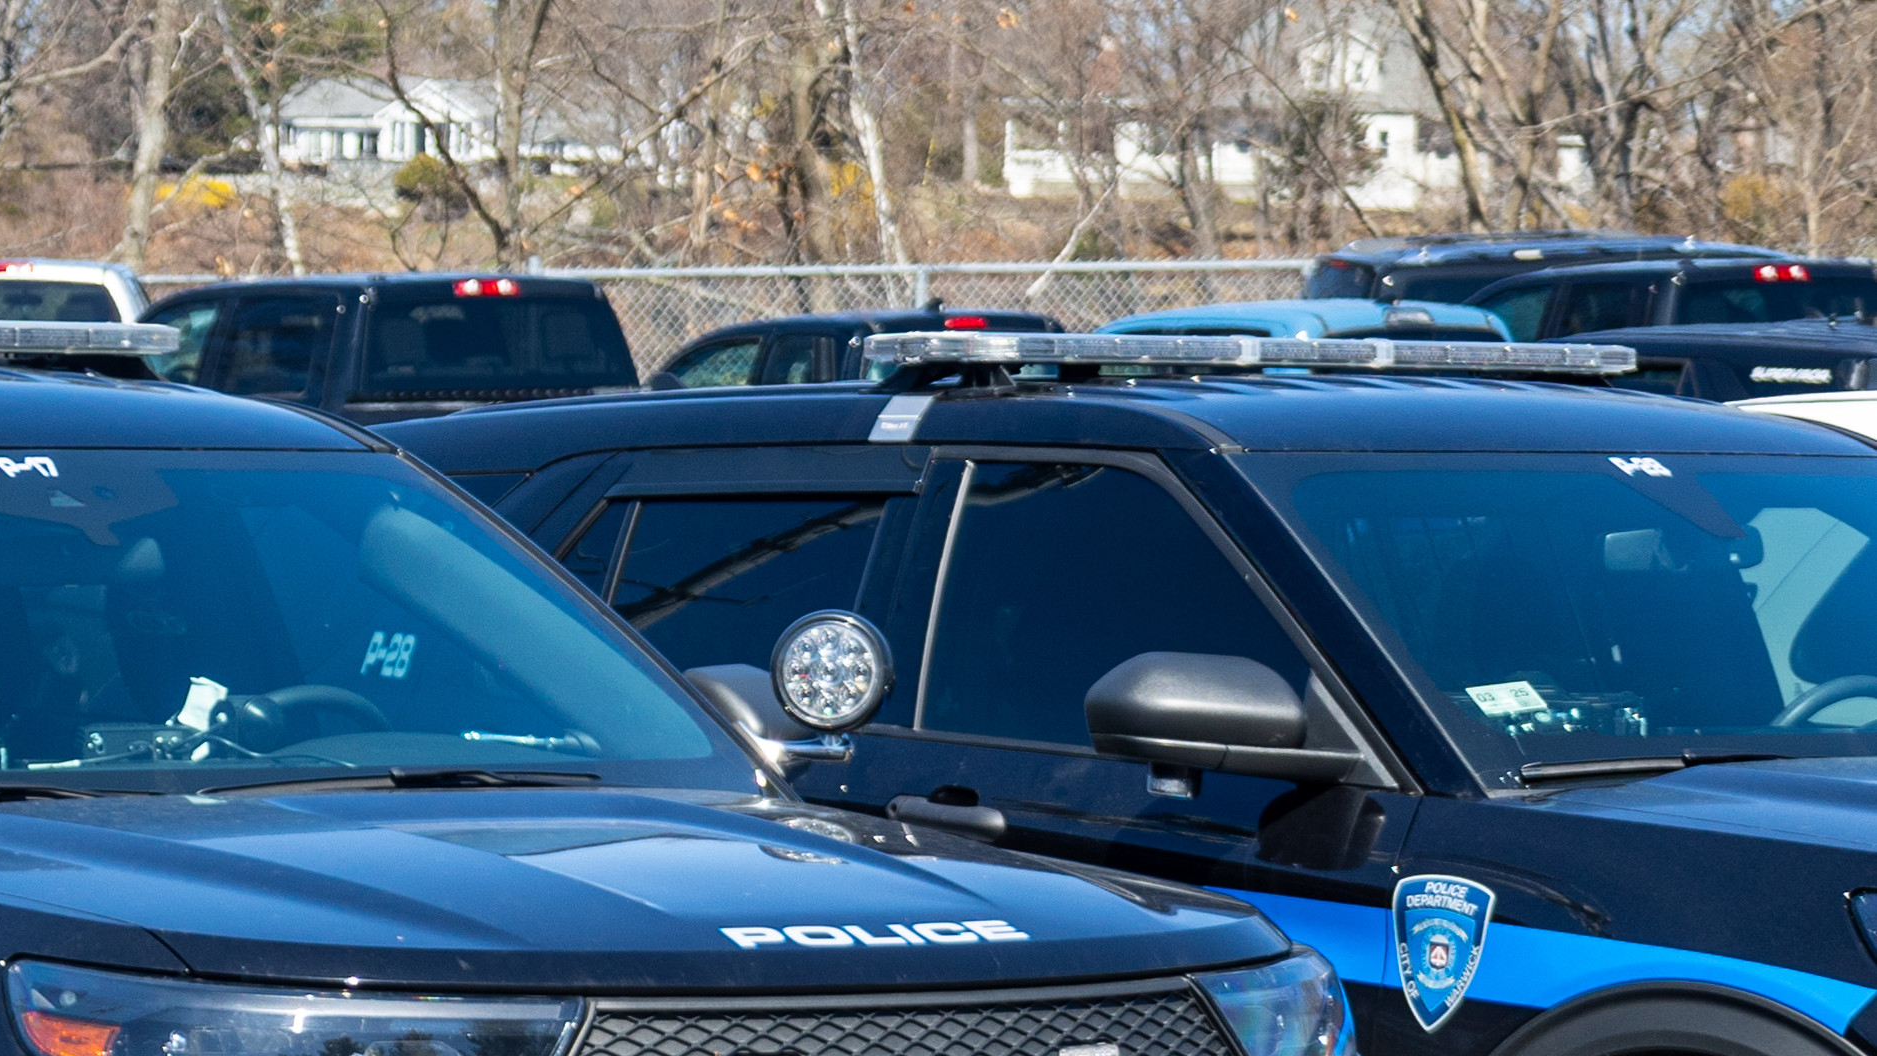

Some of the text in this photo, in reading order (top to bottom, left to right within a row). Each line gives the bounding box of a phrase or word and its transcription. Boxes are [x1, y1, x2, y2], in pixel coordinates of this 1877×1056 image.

[360, 631, 416, 678] P-28
[1405, 894, 1479, 916] DEPARTMENT
[1424, 881, 1469, 898] POLICE
[718, 919, 1031, 949] POLICE
[1399, 942, 1421, 1000] CITY OF
[1444, 945, 1481, 1007] WARWICK
